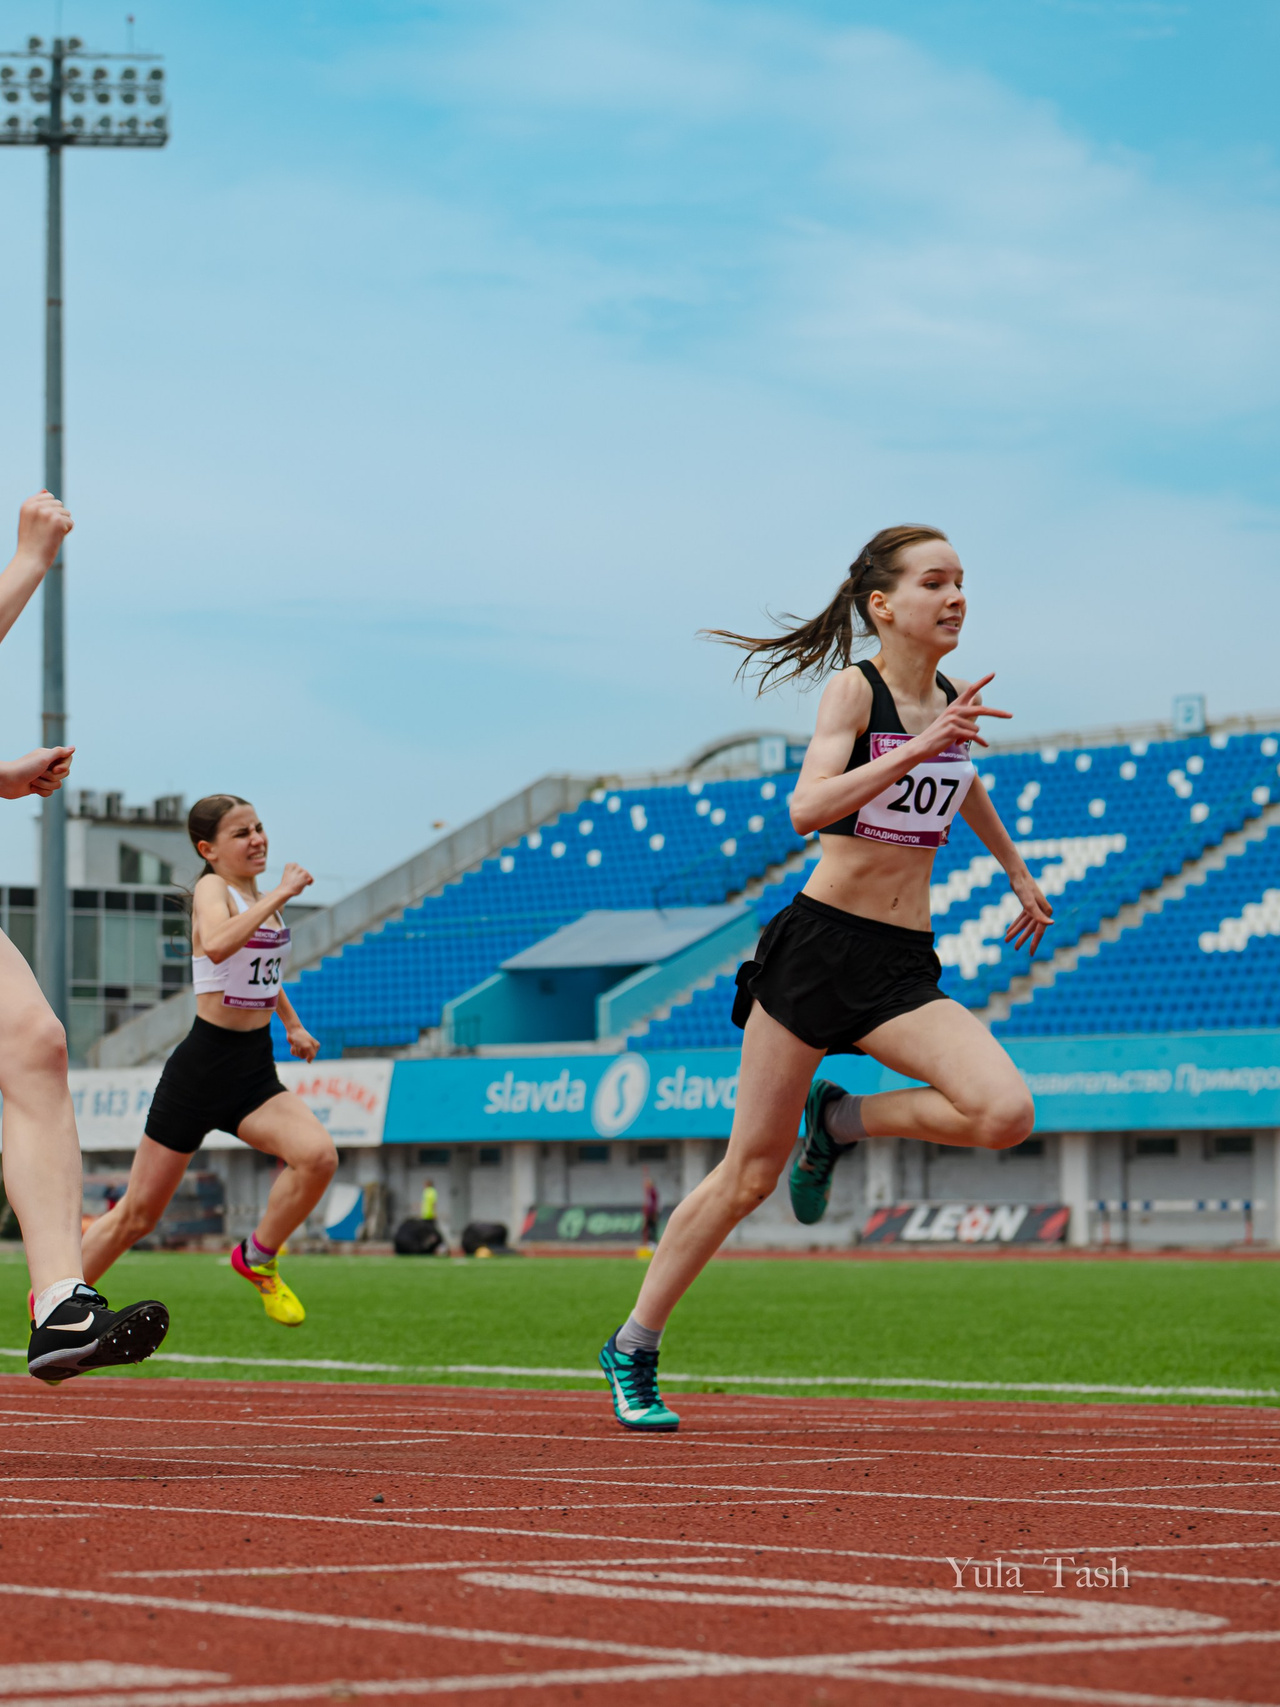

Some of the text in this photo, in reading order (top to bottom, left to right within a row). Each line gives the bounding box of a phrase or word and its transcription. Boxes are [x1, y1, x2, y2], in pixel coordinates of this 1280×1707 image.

[886, 774, 960, 816] 207
[863, 827, 921, 844] ВЛАДИВОСТОК
[247, 957, 282, 986] 133
[483, 1069, 587, 1114] slavda
[654, 1064, 741, 1111] slavd
[900, 1204, 1028, 1242] LEON
